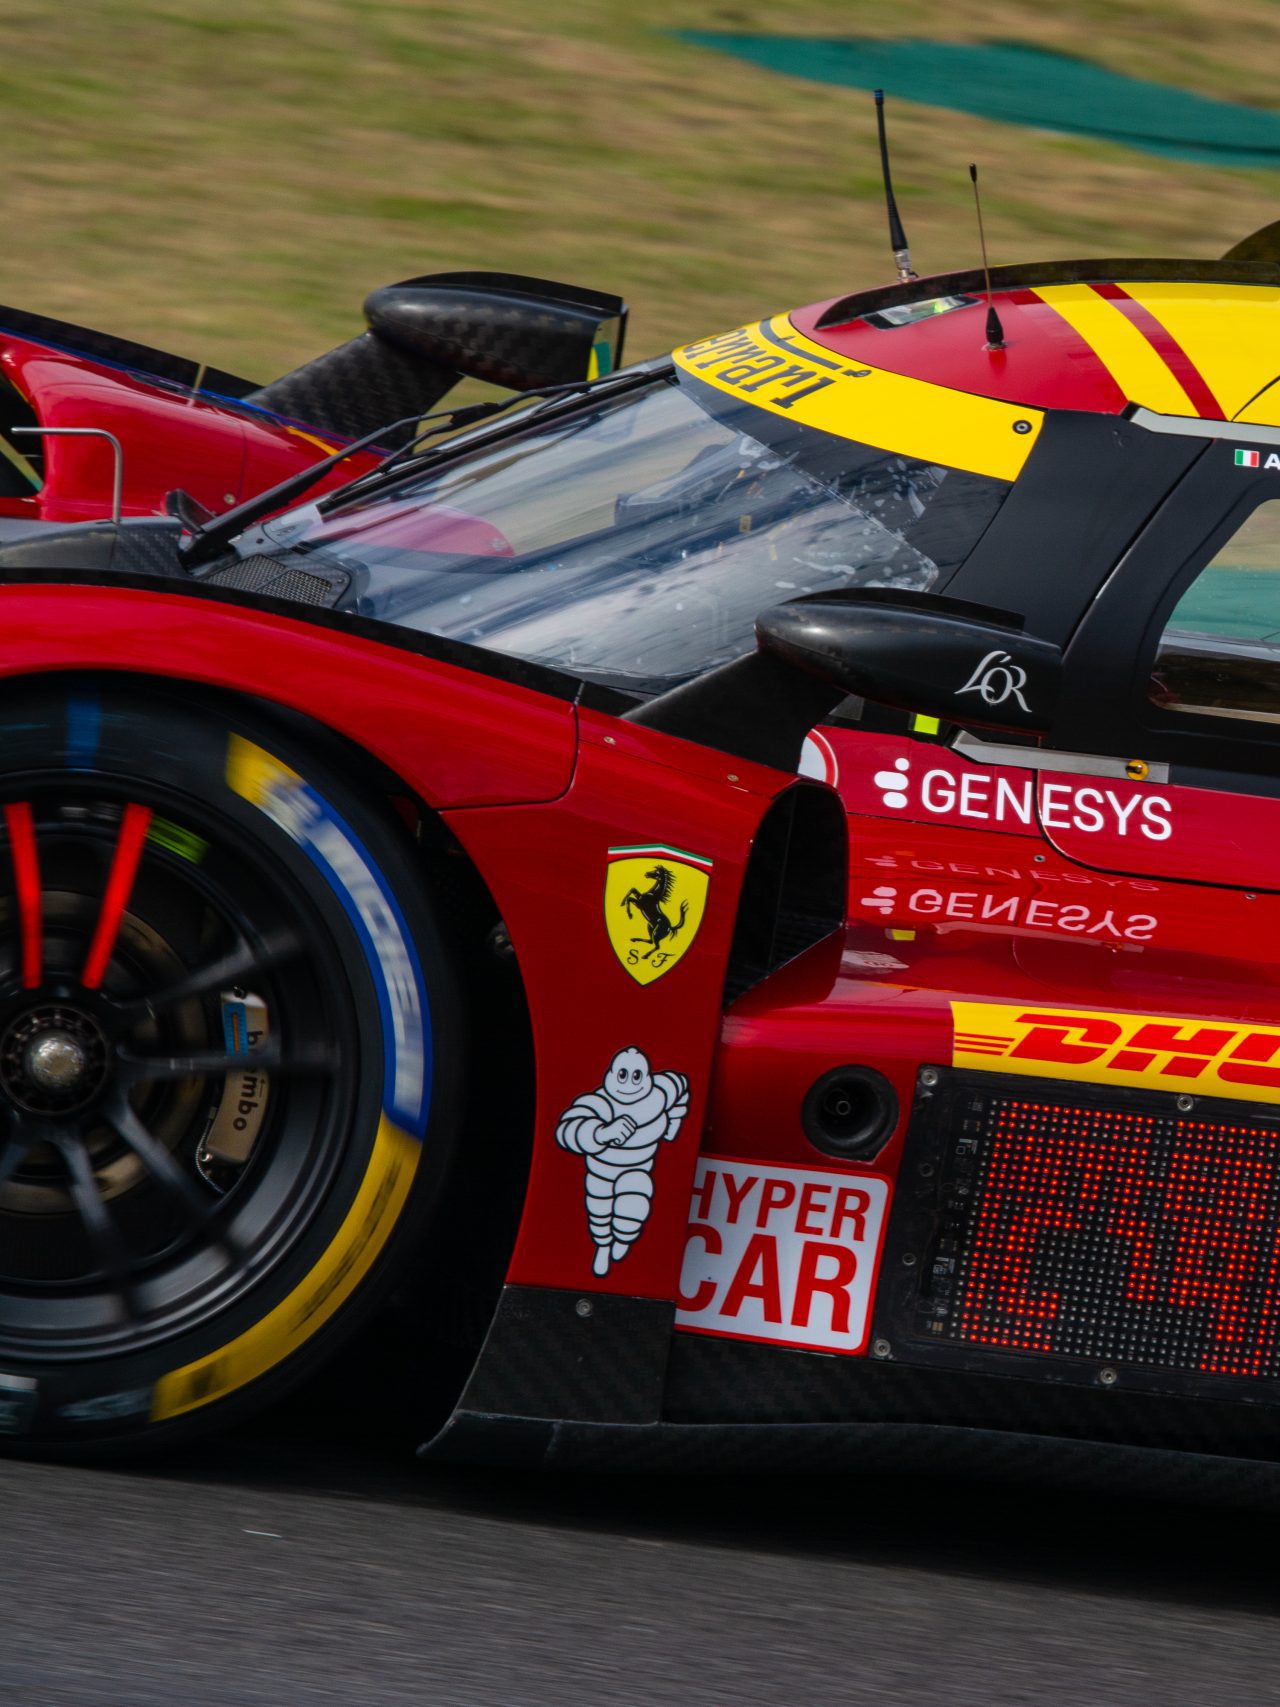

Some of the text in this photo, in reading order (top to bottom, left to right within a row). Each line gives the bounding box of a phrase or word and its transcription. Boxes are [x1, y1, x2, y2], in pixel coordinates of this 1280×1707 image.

[920, 769, 1173, 841] GENESYS
[232, 1030, 264, 1132] bmbo
[690, 1170, 872, 1242] HYPER
[676, 1222, 858, 1334] CAR
